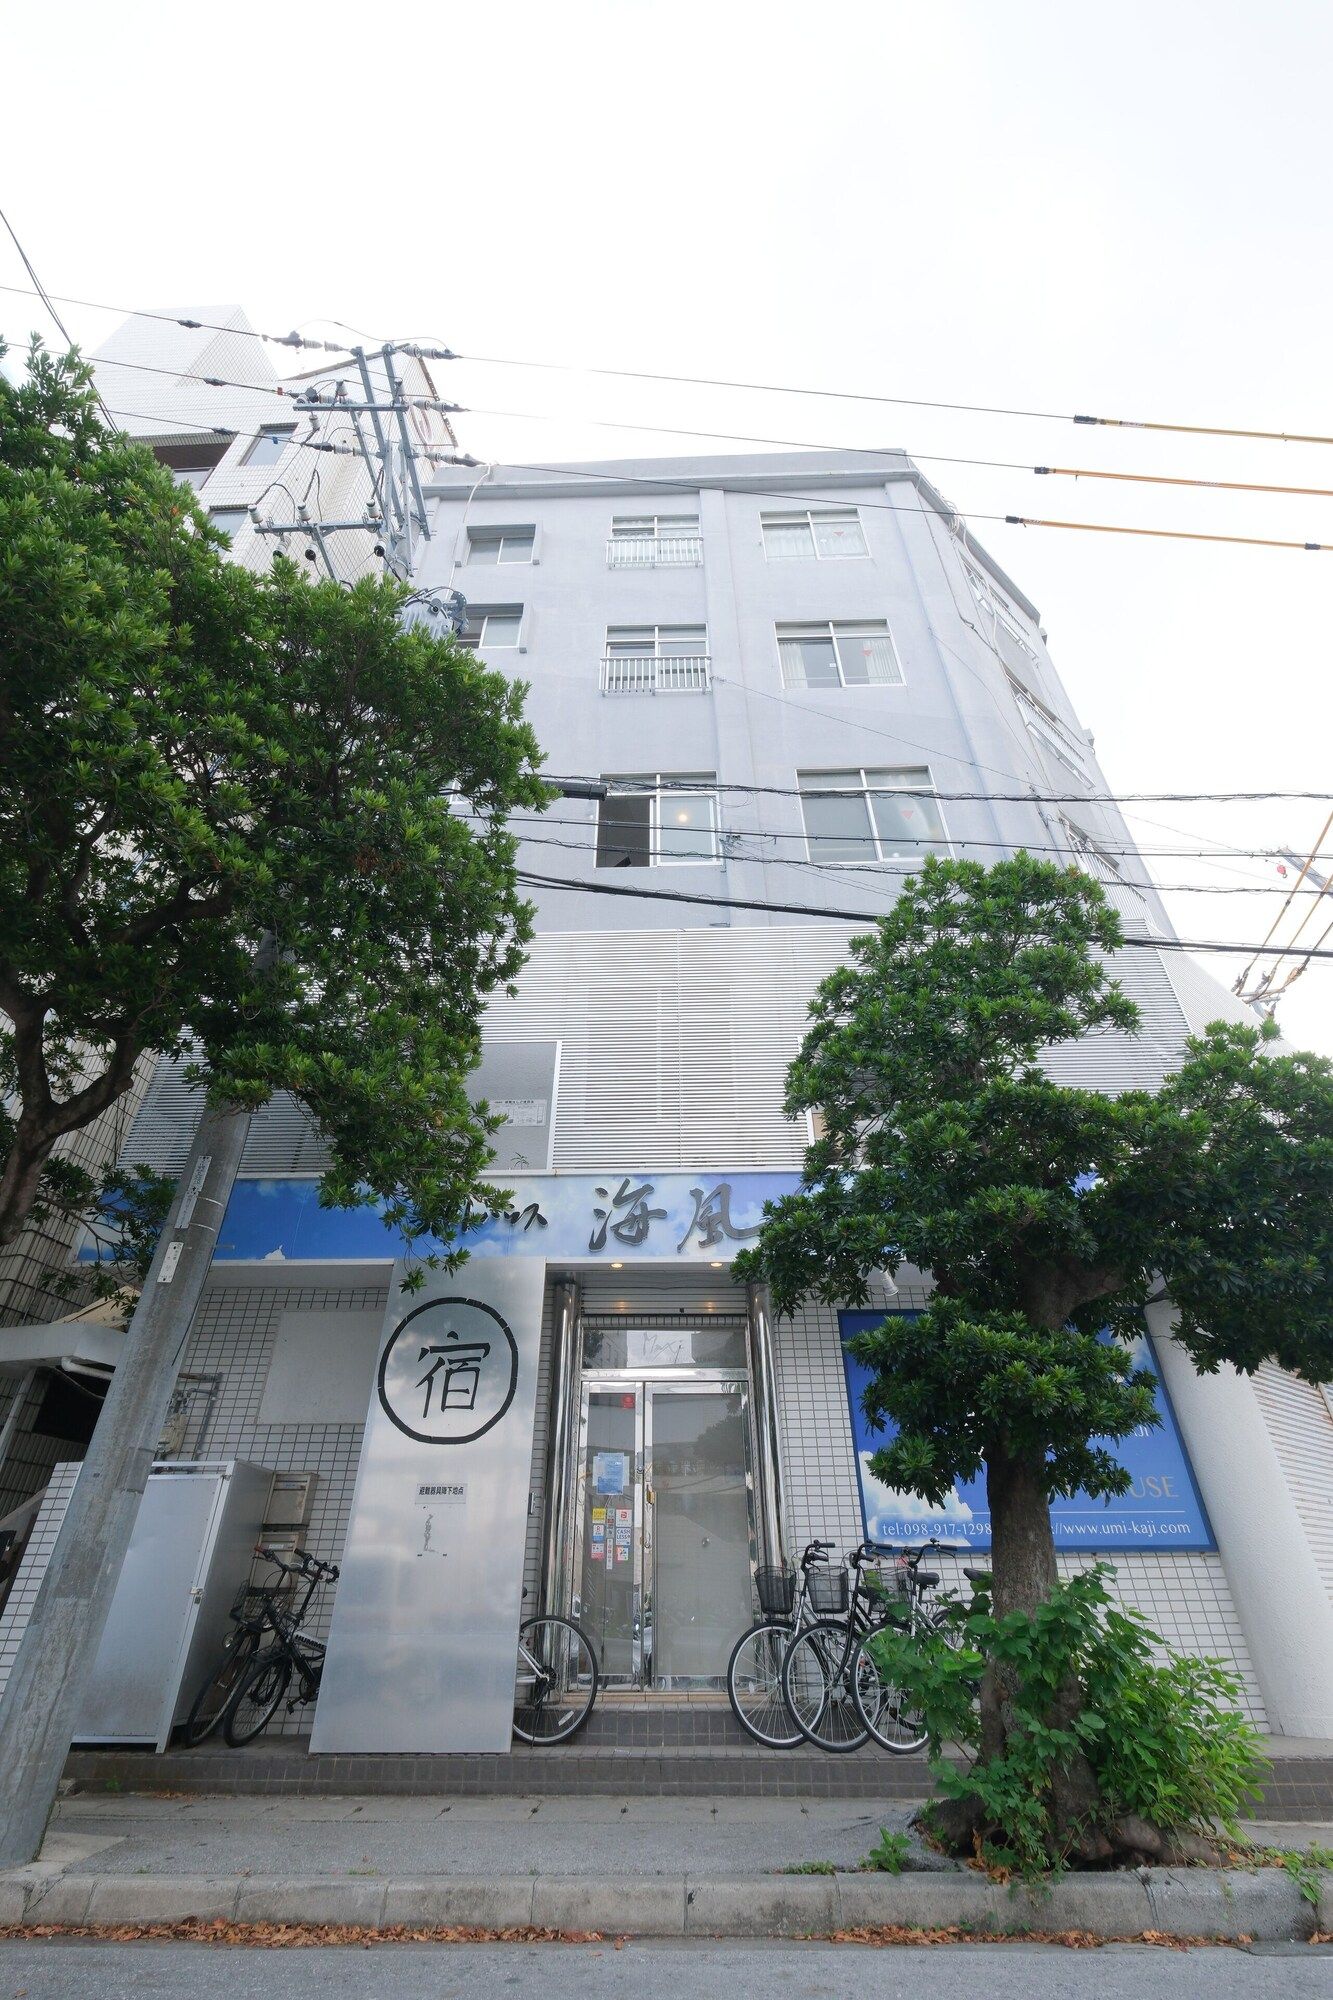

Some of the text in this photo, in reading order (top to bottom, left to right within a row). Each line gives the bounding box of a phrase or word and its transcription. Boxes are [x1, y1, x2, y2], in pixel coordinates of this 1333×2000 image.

[588, 1177, 766, 1253] 海風
[415, 1330, 491, 1418] 宿
[1131, 1475, 1180, 1499] USE
[882, 1522, 992, 1536] tel:098-917-1298
[1051, 1520, 1191, 1537] ://www.umi-kaji.com
[294, 1634, 328, 1651] HUMME
